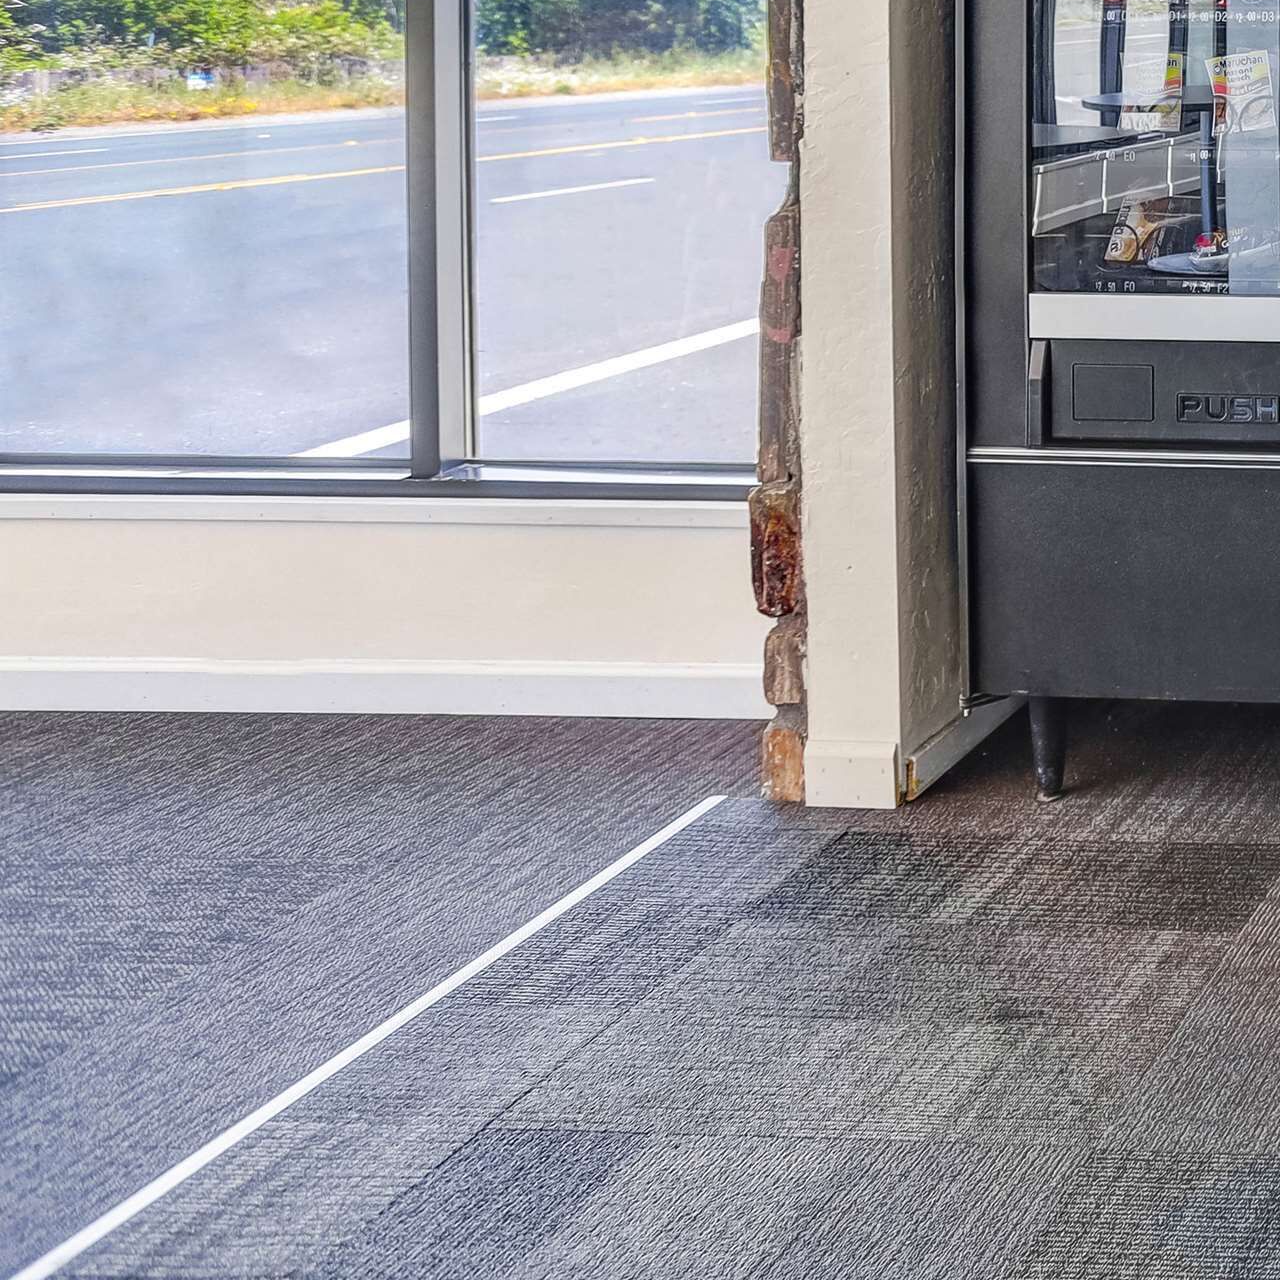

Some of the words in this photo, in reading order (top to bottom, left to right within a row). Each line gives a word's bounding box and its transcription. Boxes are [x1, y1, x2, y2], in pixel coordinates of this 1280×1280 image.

[1169, 10, 1180, 21] D1
[1215, 11, 1227, 21] D2
[1262, 12, 1274, 21] D3
[1219, 55, 1263, 70] Maruchan
[1124, 151, 1135, 161] E0
[1124, 281, 1135, 291] F0
[1217, 283, 1228, 293] F2
[1180, 398, 1278, 422] PUSH
